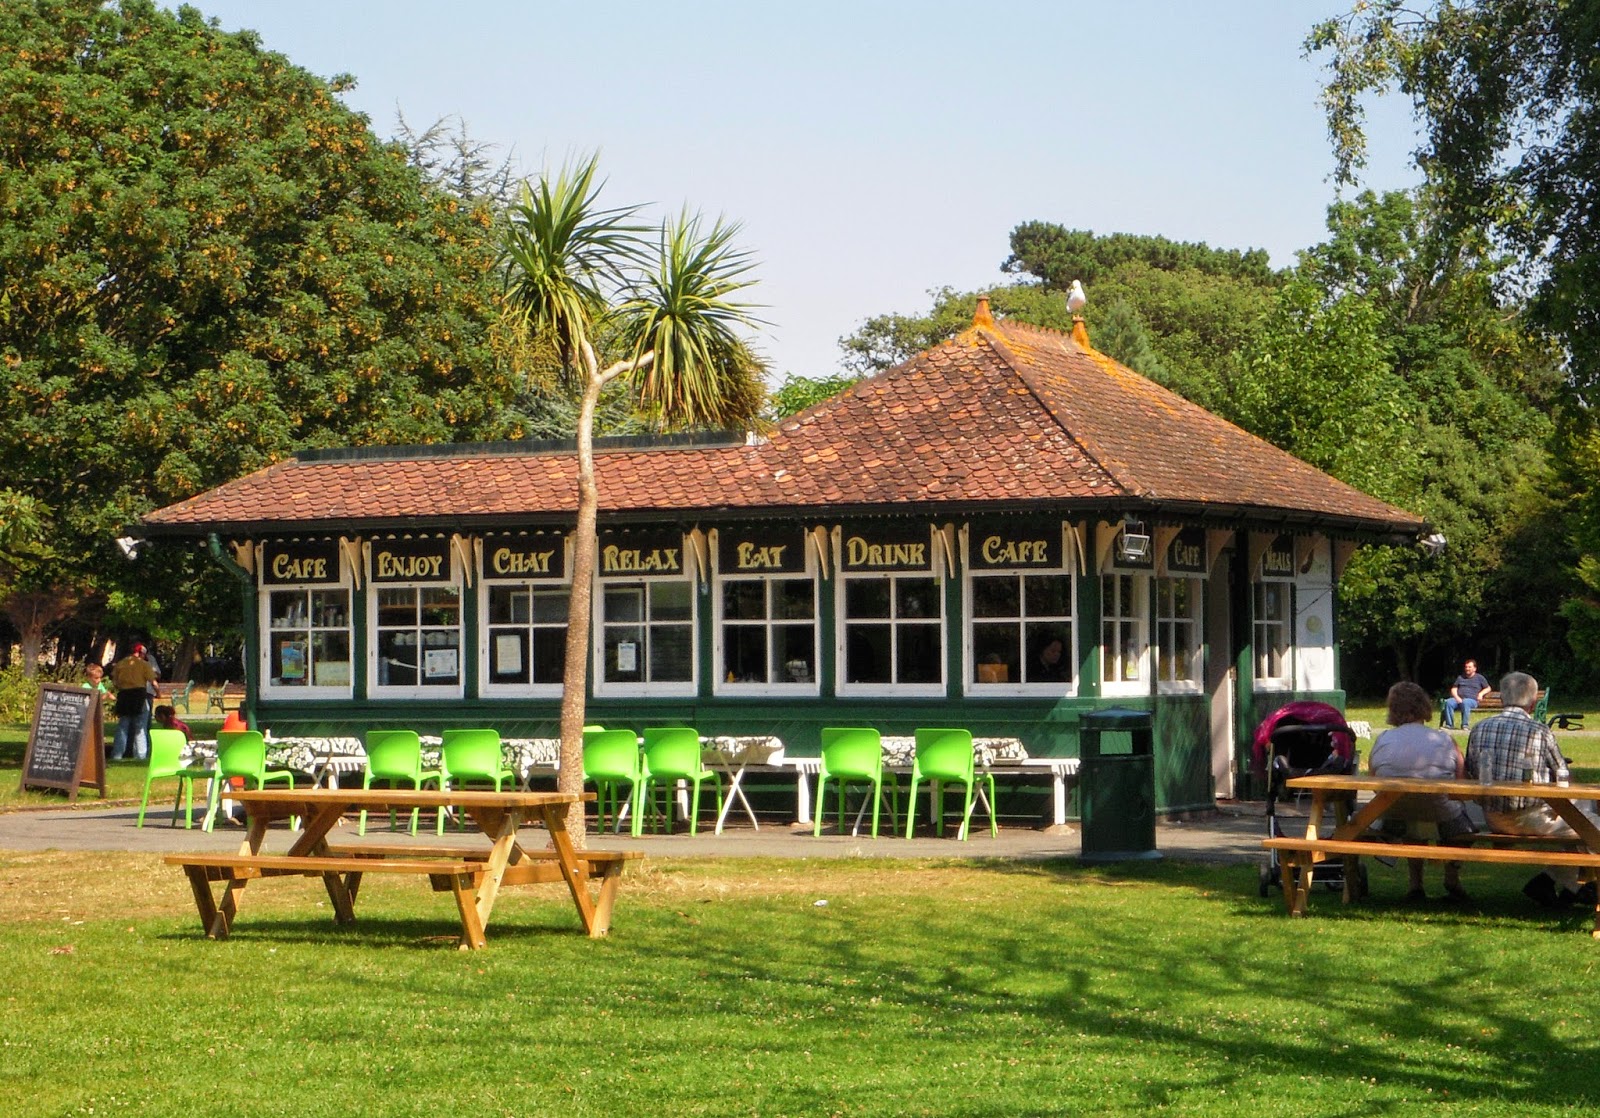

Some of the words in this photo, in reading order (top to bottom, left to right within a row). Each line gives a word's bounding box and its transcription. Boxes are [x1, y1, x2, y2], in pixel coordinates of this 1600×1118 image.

[493, 548, 555, 573] CHAT
[603, 545, 680, 572] RELAX
[737, 542, 787, 568] EAT
[847, 537, 926, 566] DRINK
[982, 535, 1047, 564] CAFE
[1174, 539, 1200, 566] CAFE
[272, 554, 328, 579] CAFE
[378, 551, 443, 578] ENJOY
